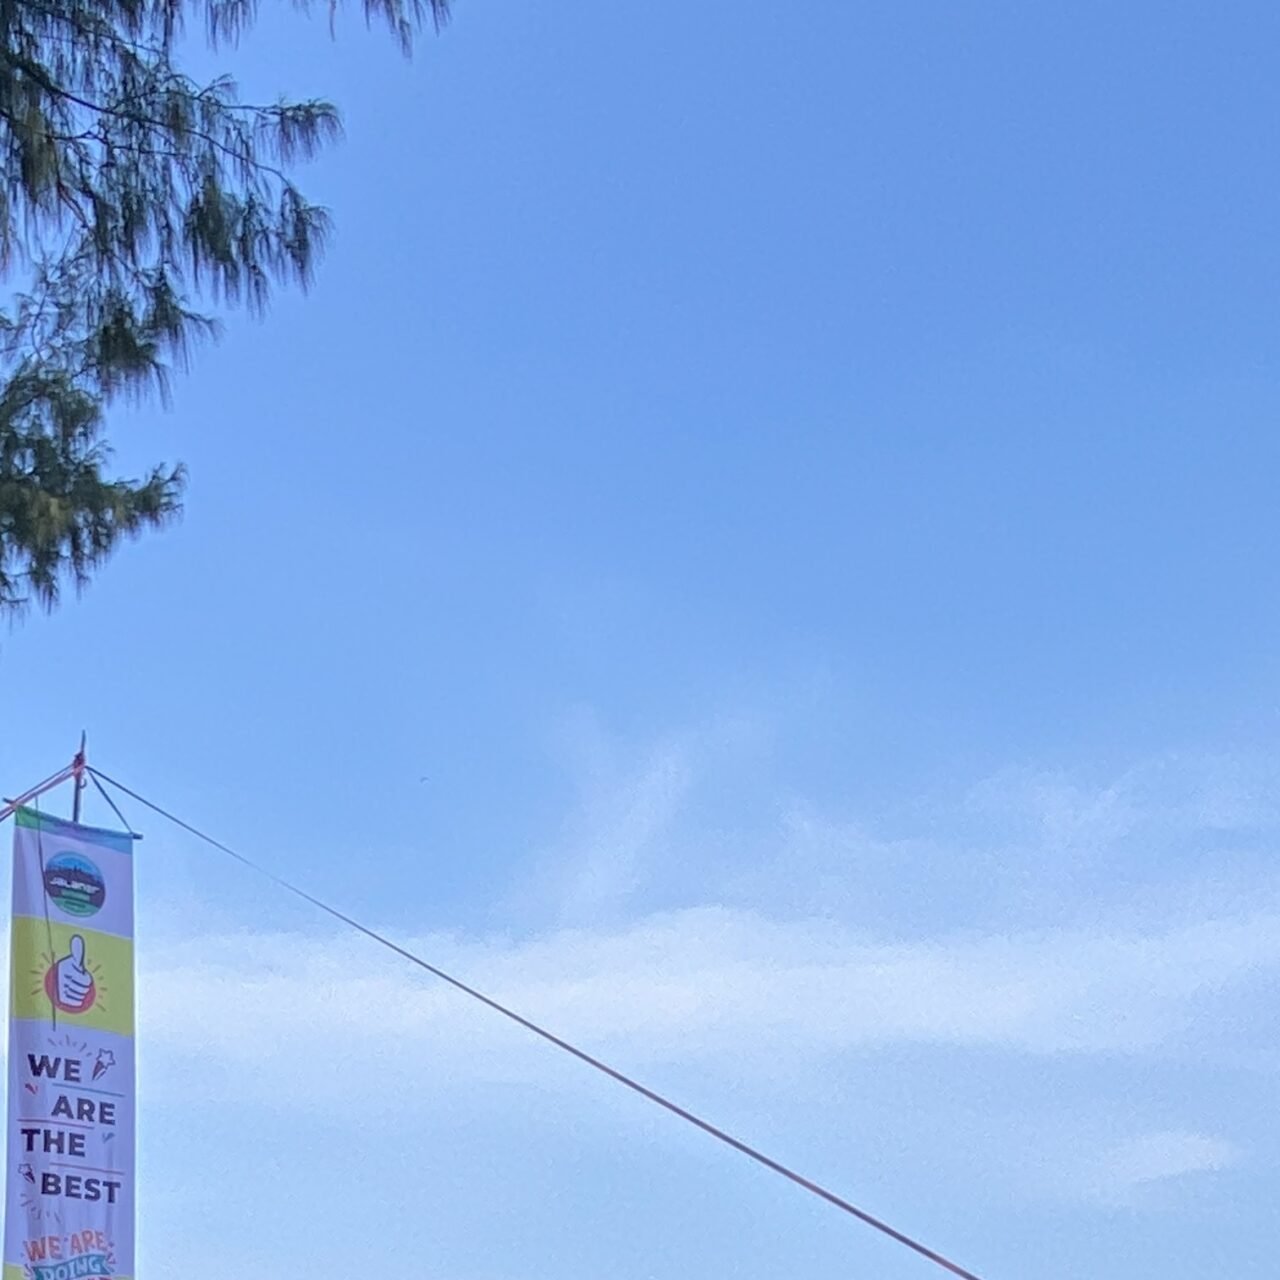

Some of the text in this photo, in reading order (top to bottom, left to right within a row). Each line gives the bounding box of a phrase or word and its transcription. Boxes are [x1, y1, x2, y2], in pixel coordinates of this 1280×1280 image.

[28, 1054, 81, 1082] WE
[51, 1095, 116, 1125] ARE
[21, 1128, 85, 1157] THE
[41, 1172, 121, 1203] BEST
[24, 1230, 107, 1262] WE ARE
